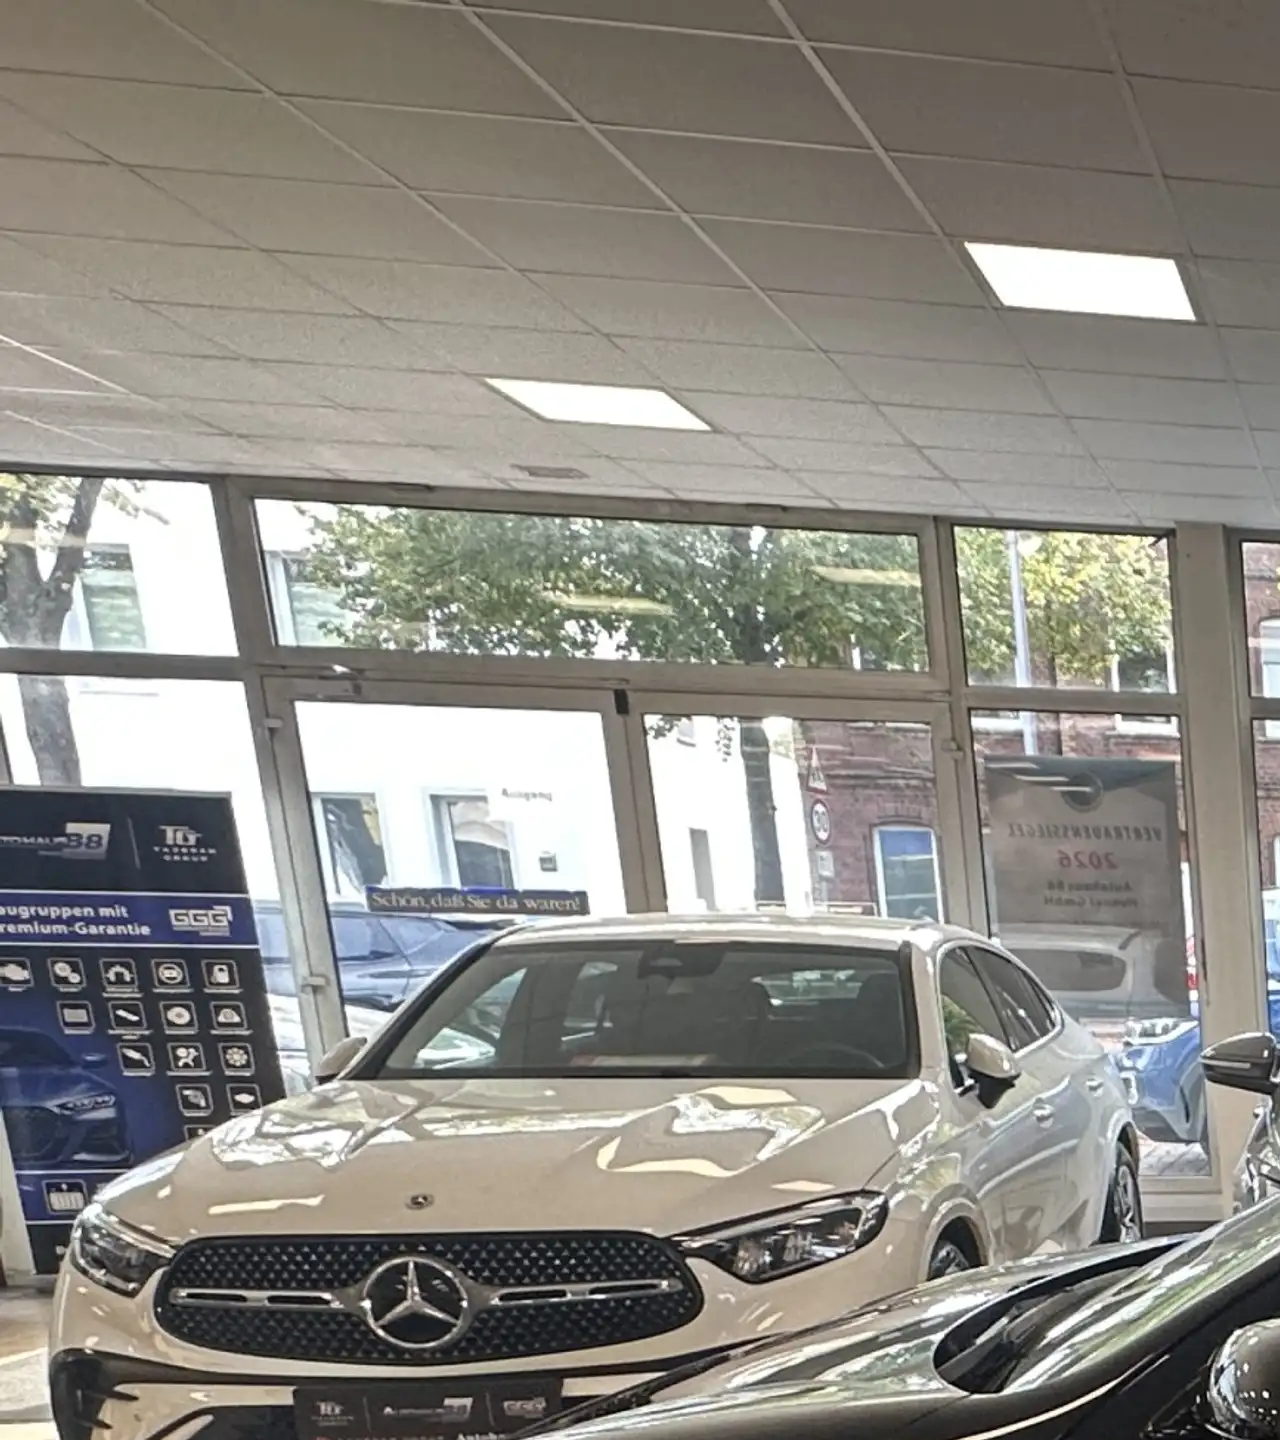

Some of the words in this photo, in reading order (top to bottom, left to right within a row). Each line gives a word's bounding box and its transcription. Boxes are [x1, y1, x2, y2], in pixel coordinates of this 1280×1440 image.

[467, 894, 490, 909] Sie
[496, 894, 518, 909] da
[524, 897, 580, 911] waren!
[98, 904, 128, 918] mit
